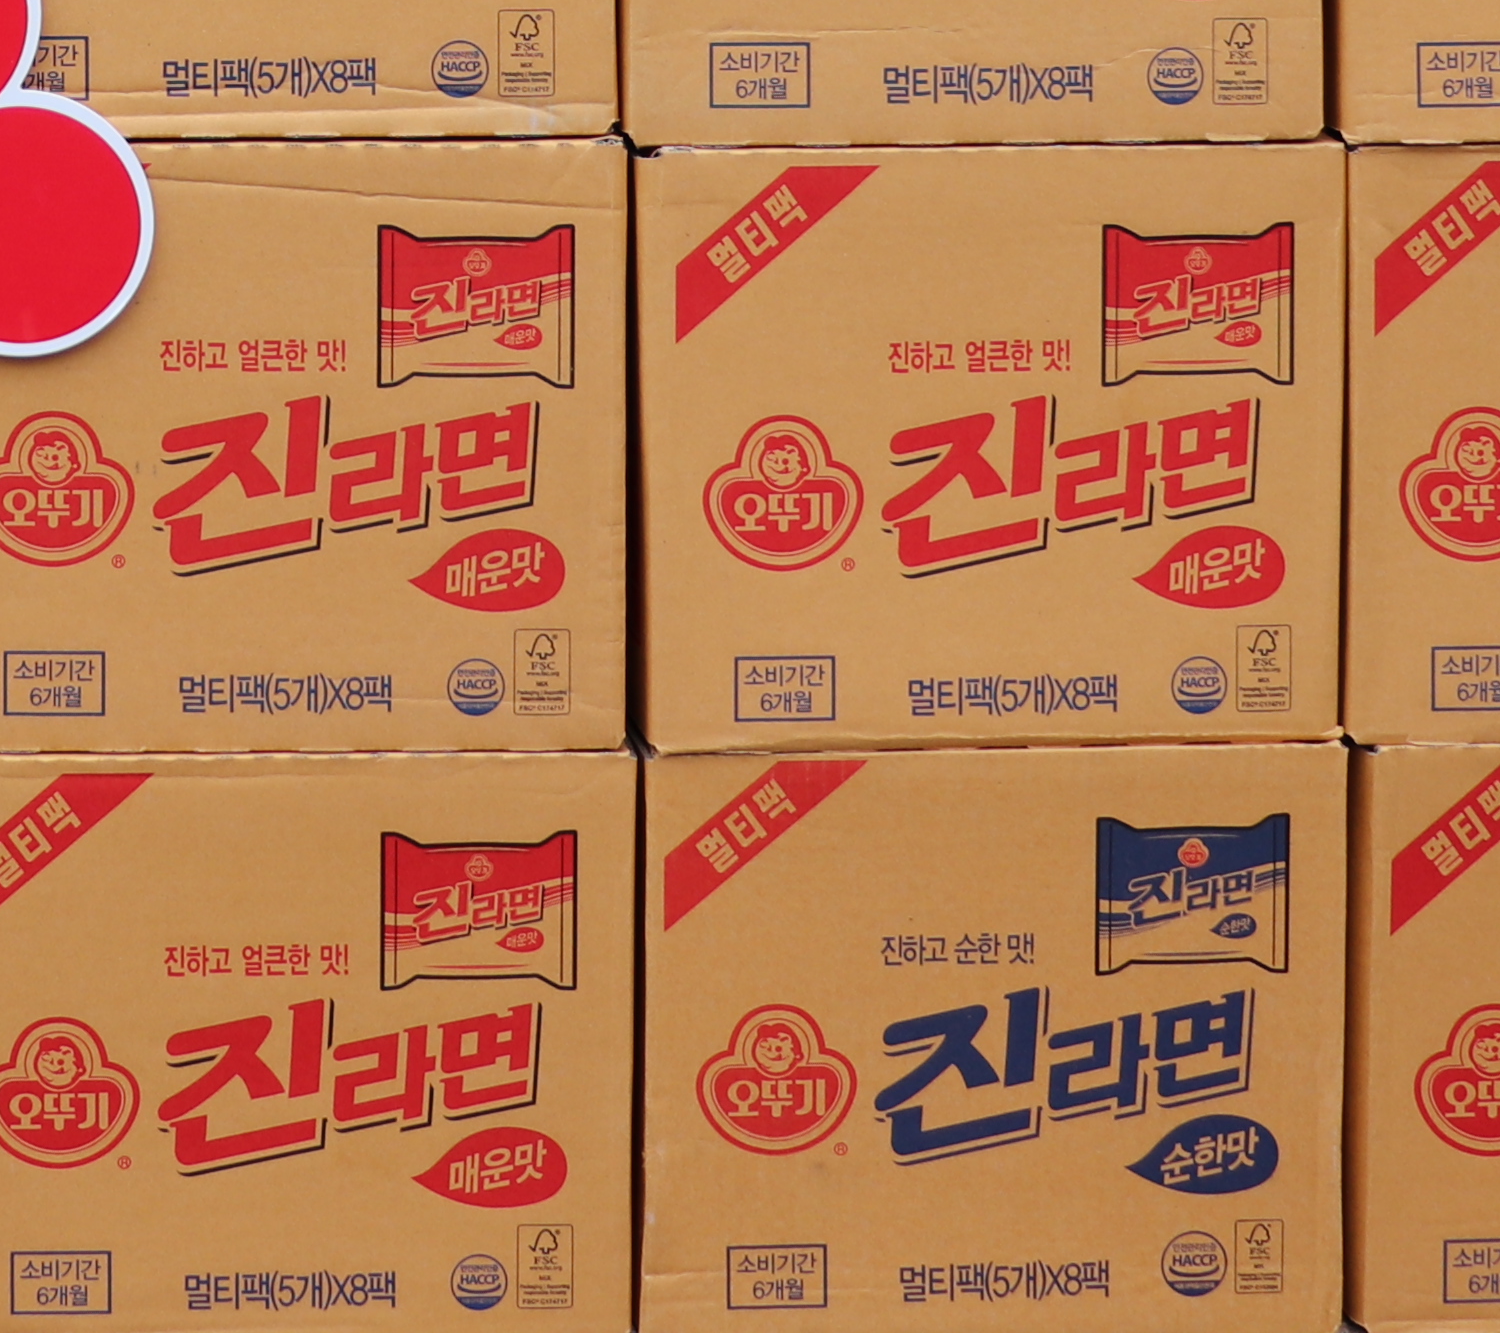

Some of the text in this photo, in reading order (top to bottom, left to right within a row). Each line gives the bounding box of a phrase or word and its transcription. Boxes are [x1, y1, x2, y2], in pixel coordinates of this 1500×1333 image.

[153, 395, 539, 579] 진라면
[735, 491, 833, 534] 오뚜기
[881, 394, 1260, 578] 진라면
[446, 542, 545, 598] 매운맛
[1169, 539, 1266, 595] 매운맛
[456, 679, 496, 692] HACCP
[163, 946, 232, 977] 진하고
[242, 944, 311, 977] 얼큰한
[880, 935, 949, 966] 진하고
[953, 934, 1001, 965] 순한
[157, 998, 542, 1177] 진라면
[874, 985, 1256, 1166] 진라면
[449, 1140, 548, 1195] 매운맛
[1160, 1127, 1259, 1185] 순한맛
